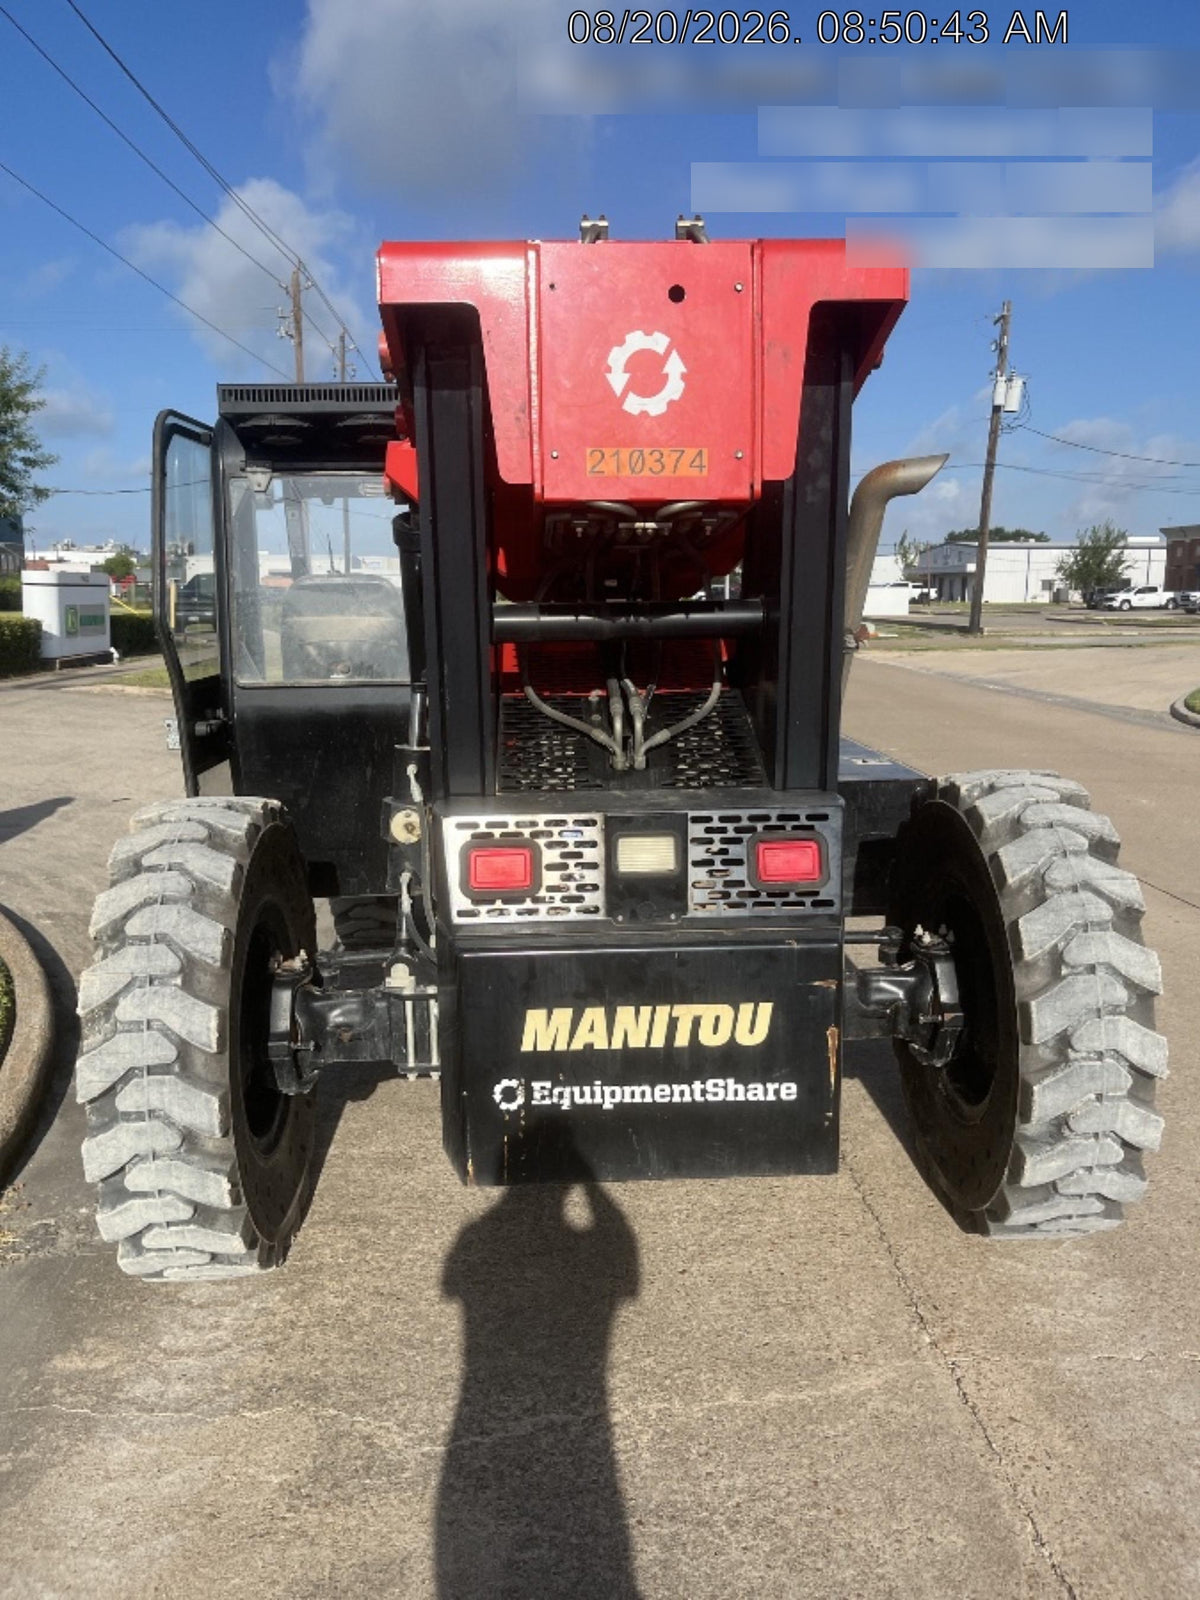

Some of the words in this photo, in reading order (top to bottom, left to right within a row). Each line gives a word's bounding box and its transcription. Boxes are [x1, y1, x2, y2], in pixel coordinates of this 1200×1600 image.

[588, 448, 707, 475] 210374
[520, 1002, 775, 1052] MANITOU
[530, 1078, 798, 1110] EquipmentShare
